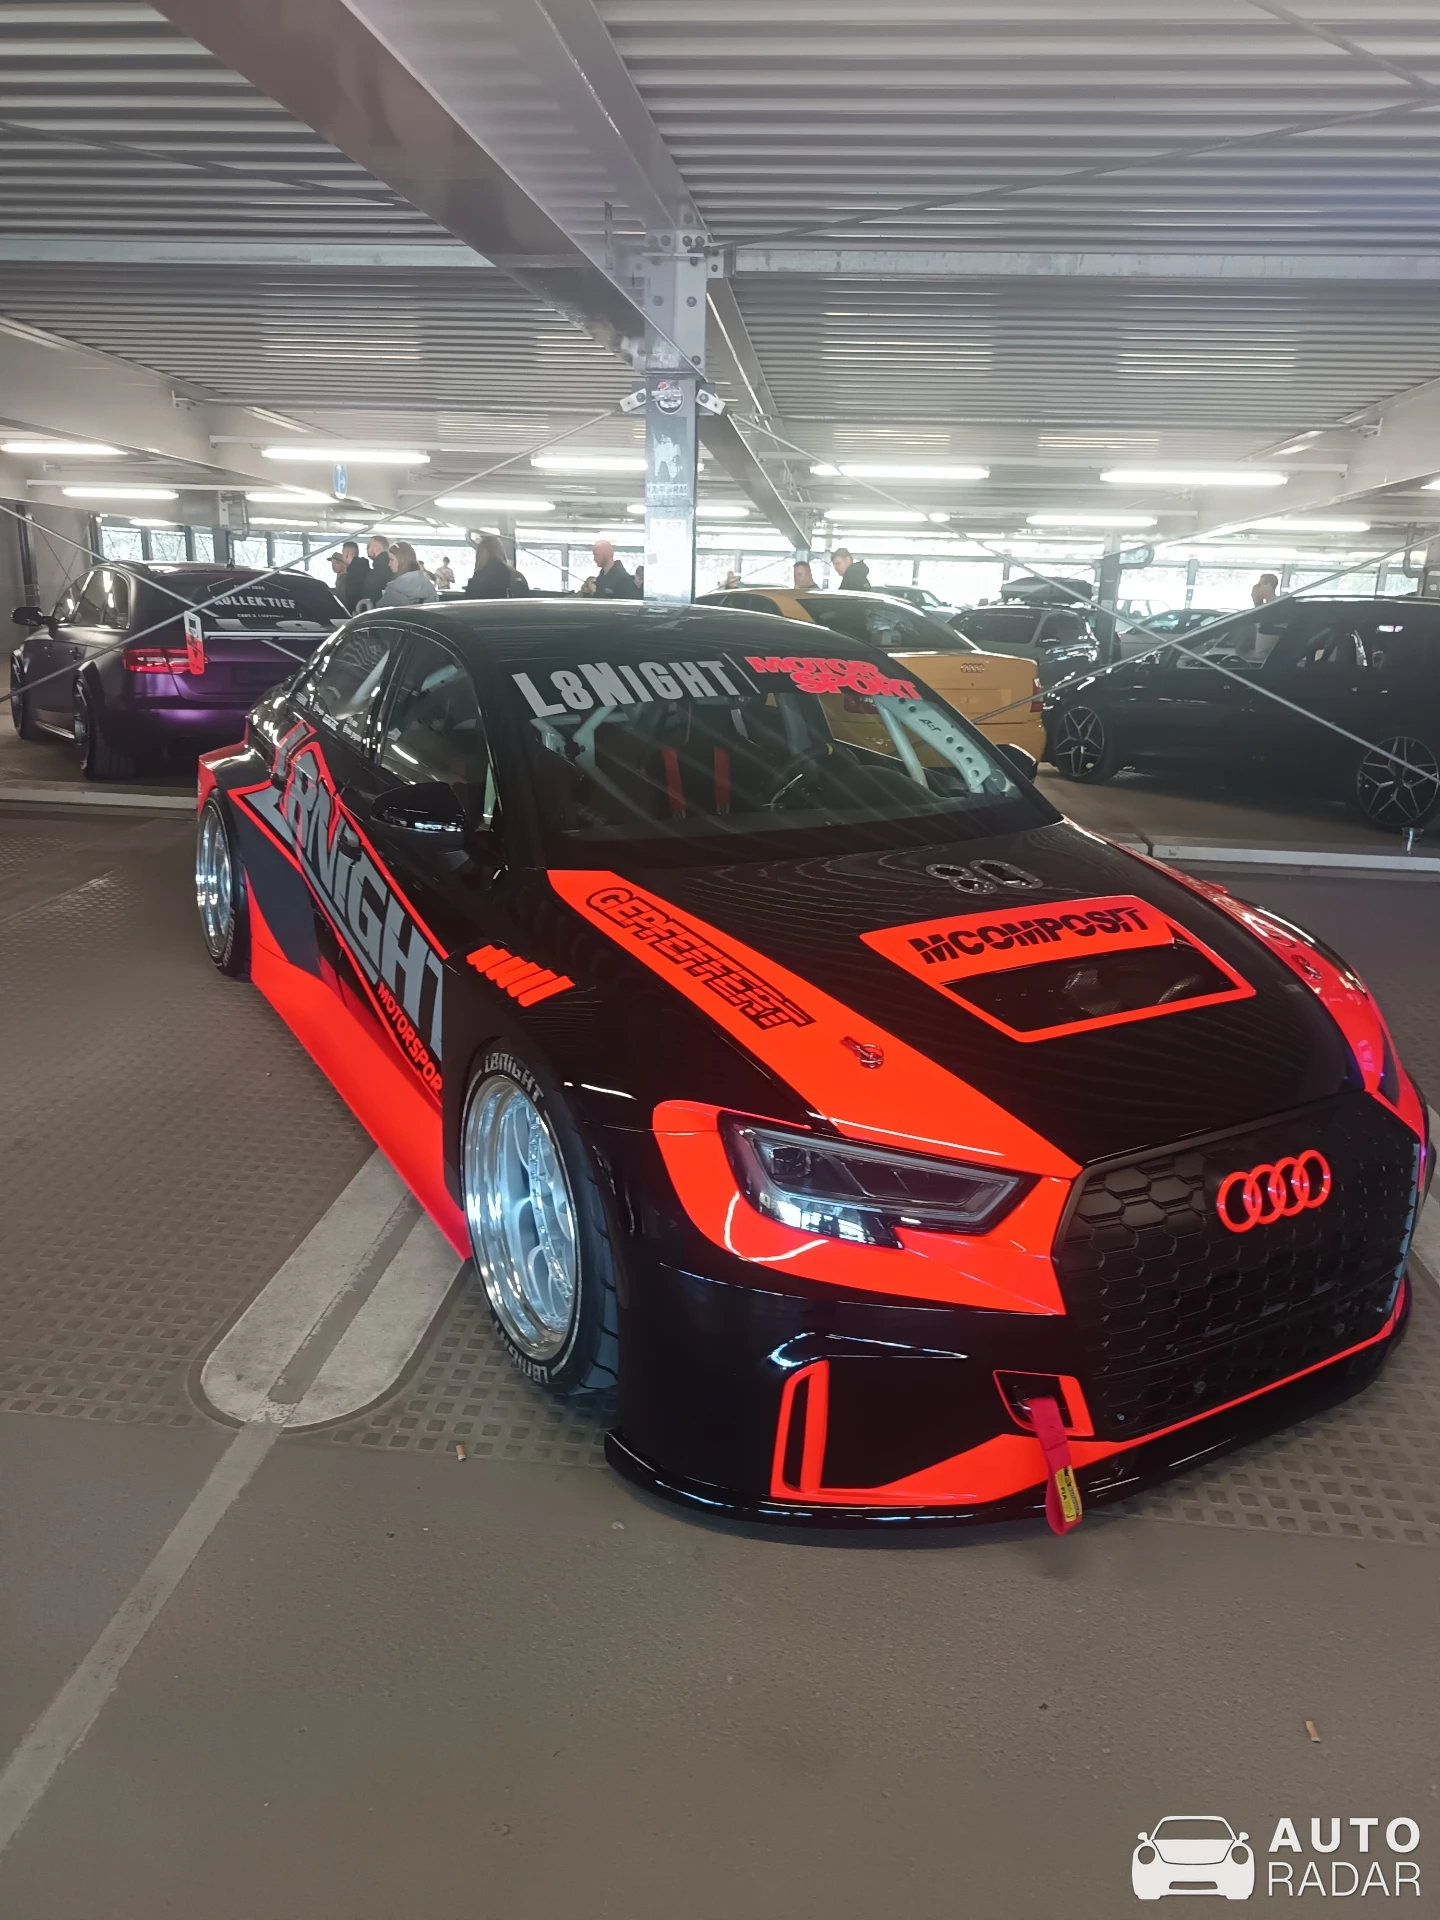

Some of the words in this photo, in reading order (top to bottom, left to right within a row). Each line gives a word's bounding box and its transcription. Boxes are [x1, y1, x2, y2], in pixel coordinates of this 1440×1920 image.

[512, 660, 739, 718] L8NIGHT
[744, 656, 888, 678] MOTOR
[790, 672, 922, 700] SPORT
[926, 859, 1043, 894] 80
[586, 887, 816, 1030] GEPFEFFERT
[908, 907, 1148, 964] MCOMPOSIT
